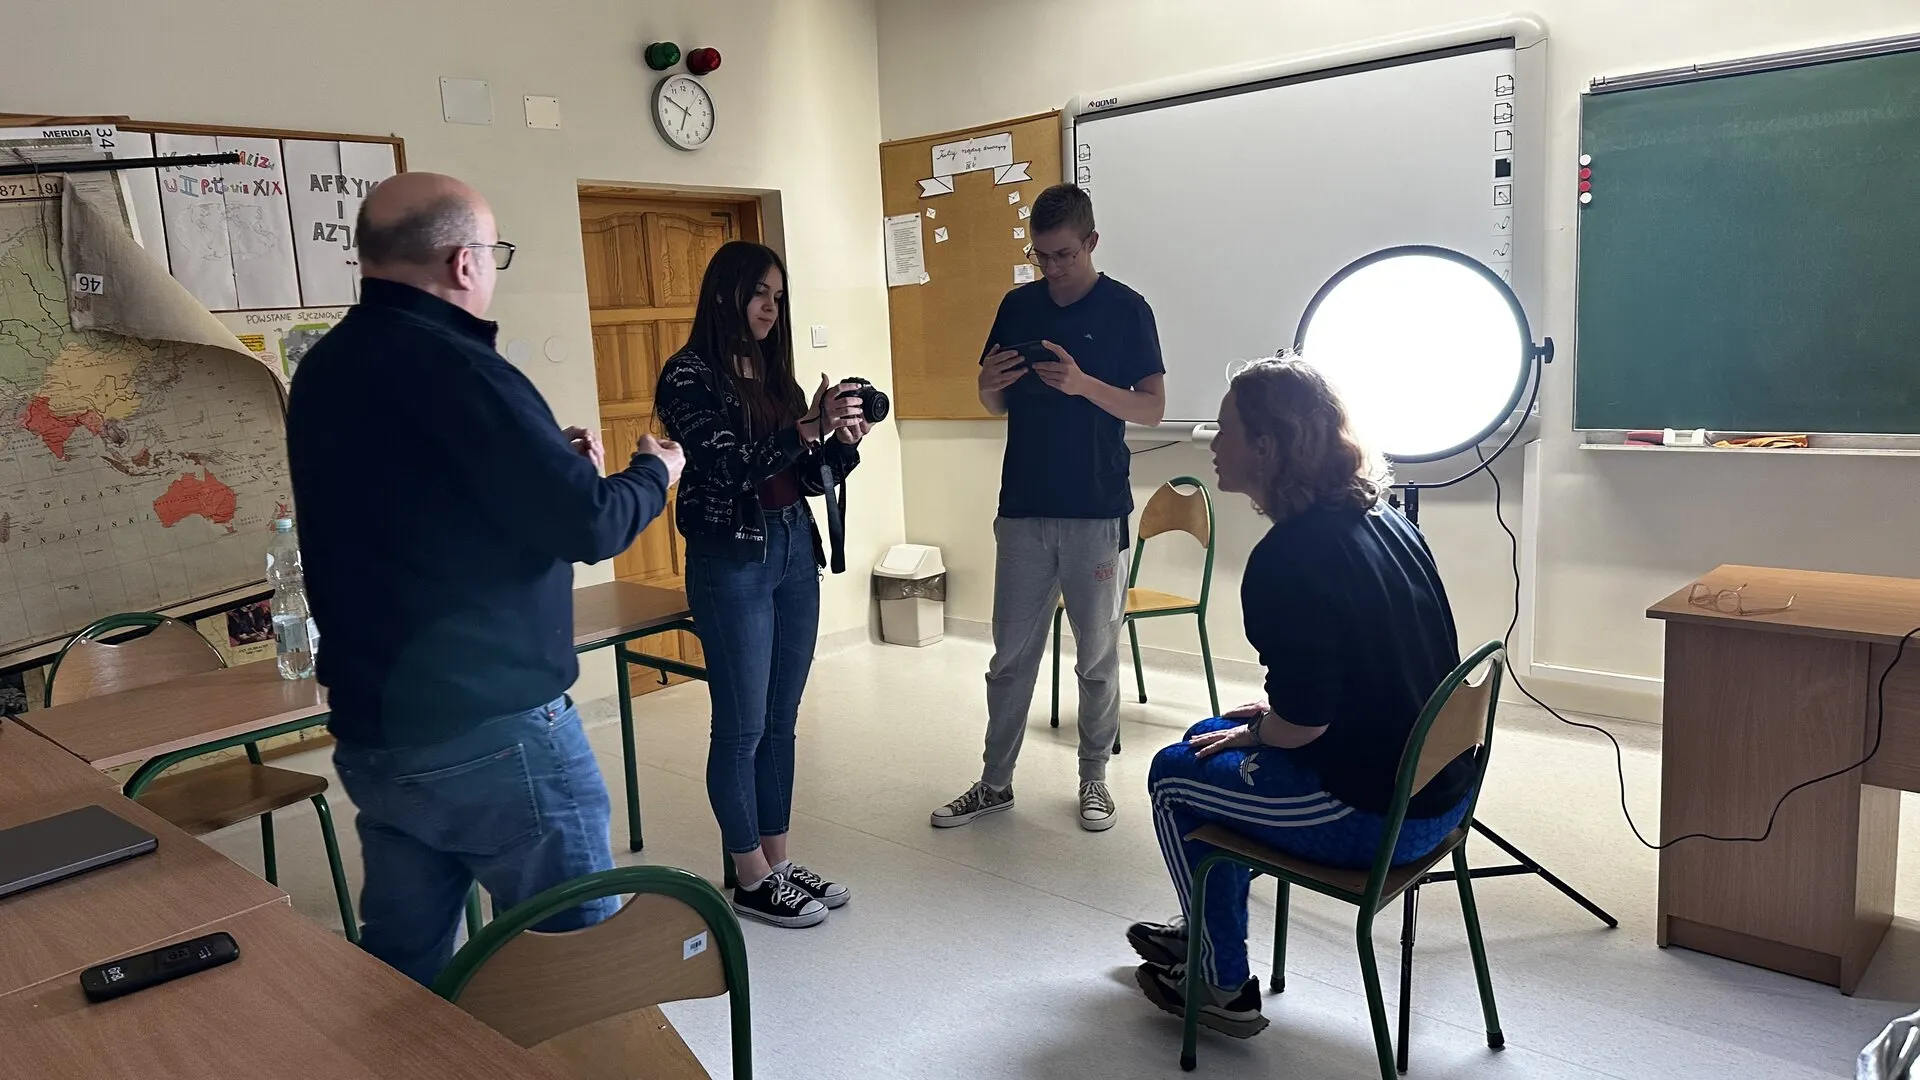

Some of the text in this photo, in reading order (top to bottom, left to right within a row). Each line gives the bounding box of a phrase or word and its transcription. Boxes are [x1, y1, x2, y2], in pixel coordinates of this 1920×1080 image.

[96, 128, 115, 149] 34
[313, 221, 359, 251] AZJ
[80, 276, 101, 292] 46
